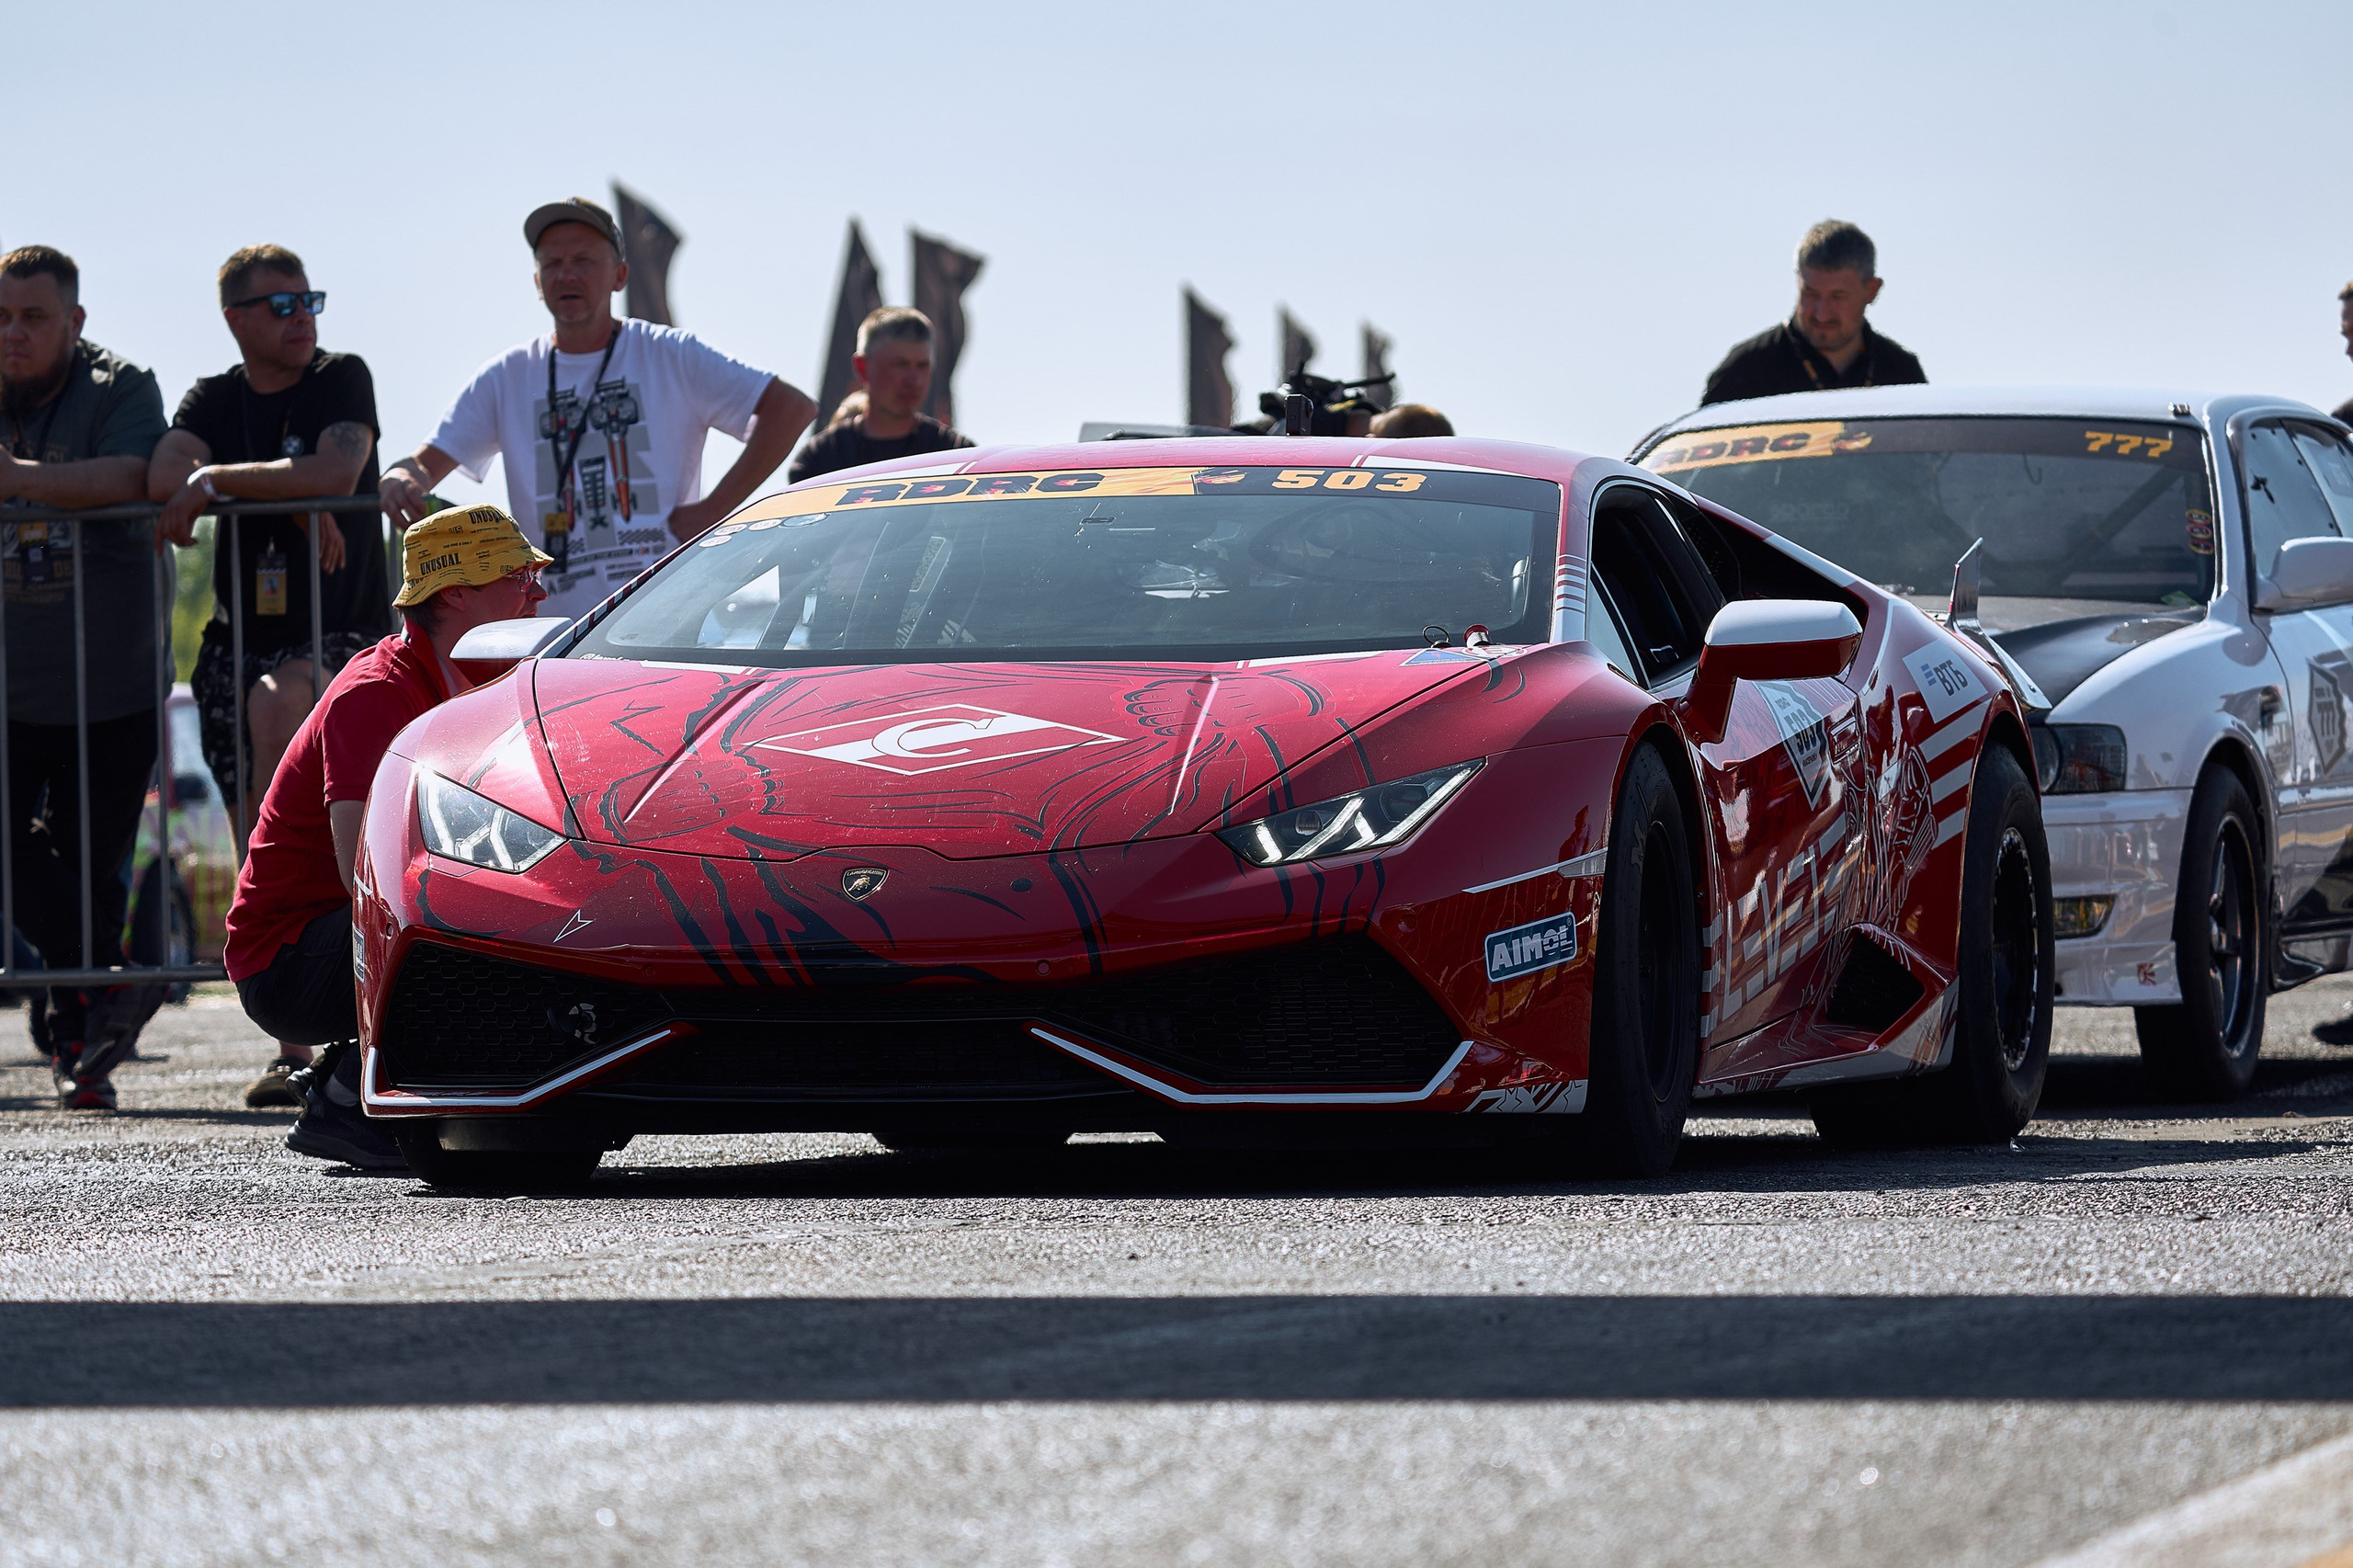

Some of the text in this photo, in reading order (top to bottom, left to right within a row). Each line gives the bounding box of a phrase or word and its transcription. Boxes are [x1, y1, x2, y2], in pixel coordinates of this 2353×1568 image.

[2085, 431, 2173, 458] 777
[835, 470, 1427, 506] RDRC 503
[420, 552, 461, 575] UNUSUAL
[1933, 659, 1969, 697] ВТБ
[1783, 708, 1817, 755] 503
[1491, 925, 1574, 972] AIMOL
